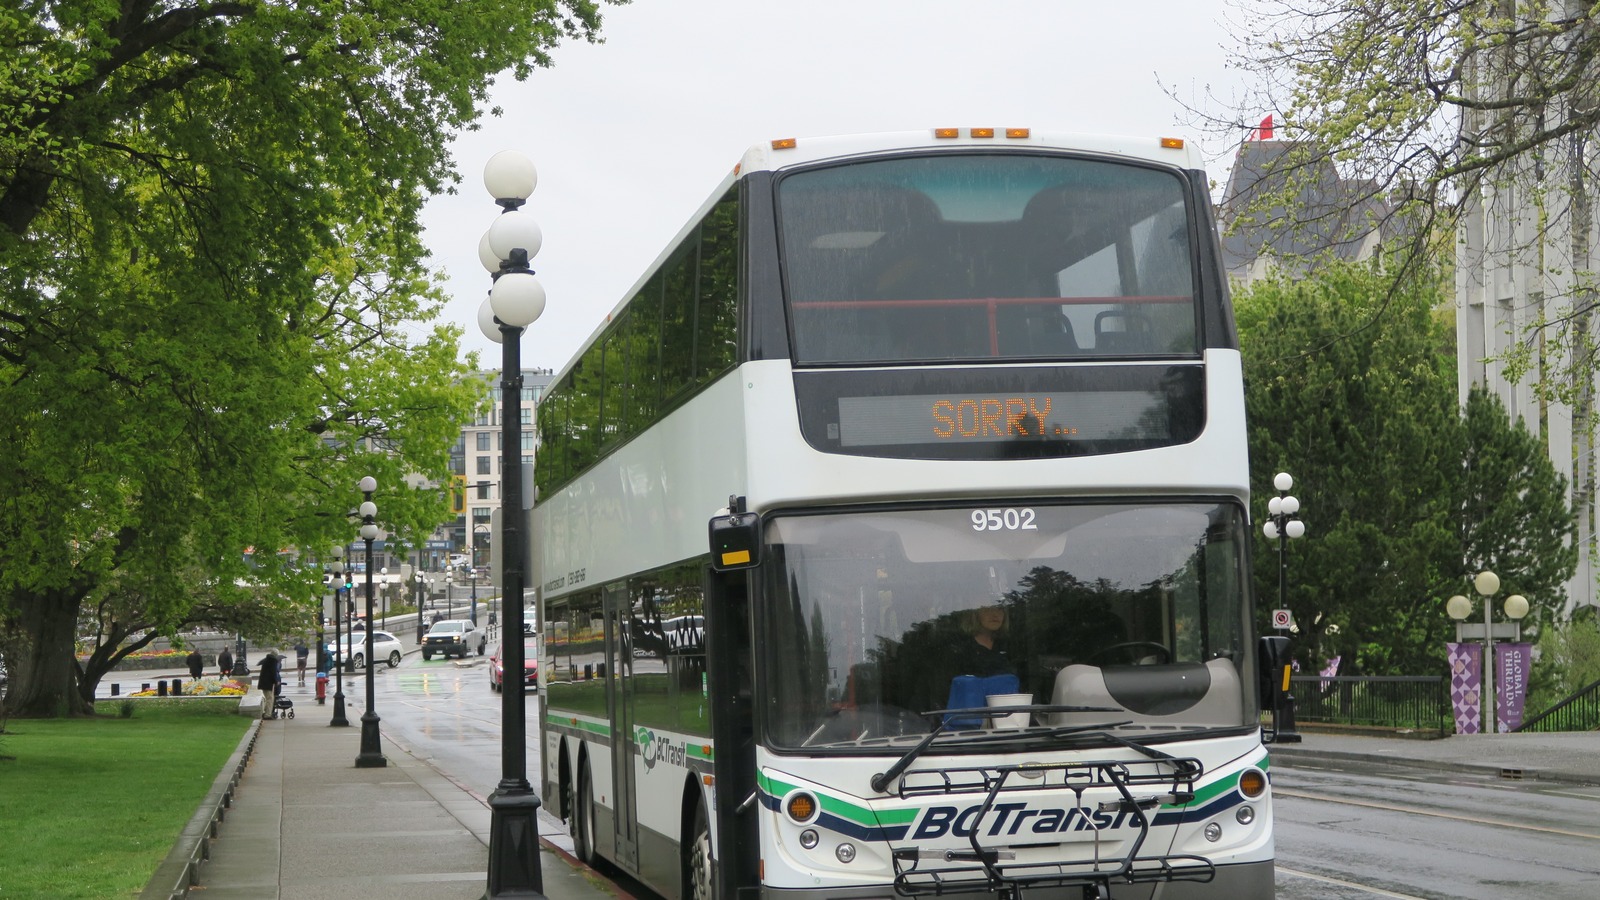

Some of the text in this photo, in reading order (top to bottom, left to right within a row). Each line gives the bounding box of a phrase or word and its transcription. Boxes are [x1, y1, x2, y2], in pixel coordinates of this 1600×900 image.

[932, 397, 1079, 438] SORRY...
[971, 508, 1038, 531] 9502
[1505, 650, 1514, 707] THREADS
[1513, 650, 1523, 698] GLOBAL
